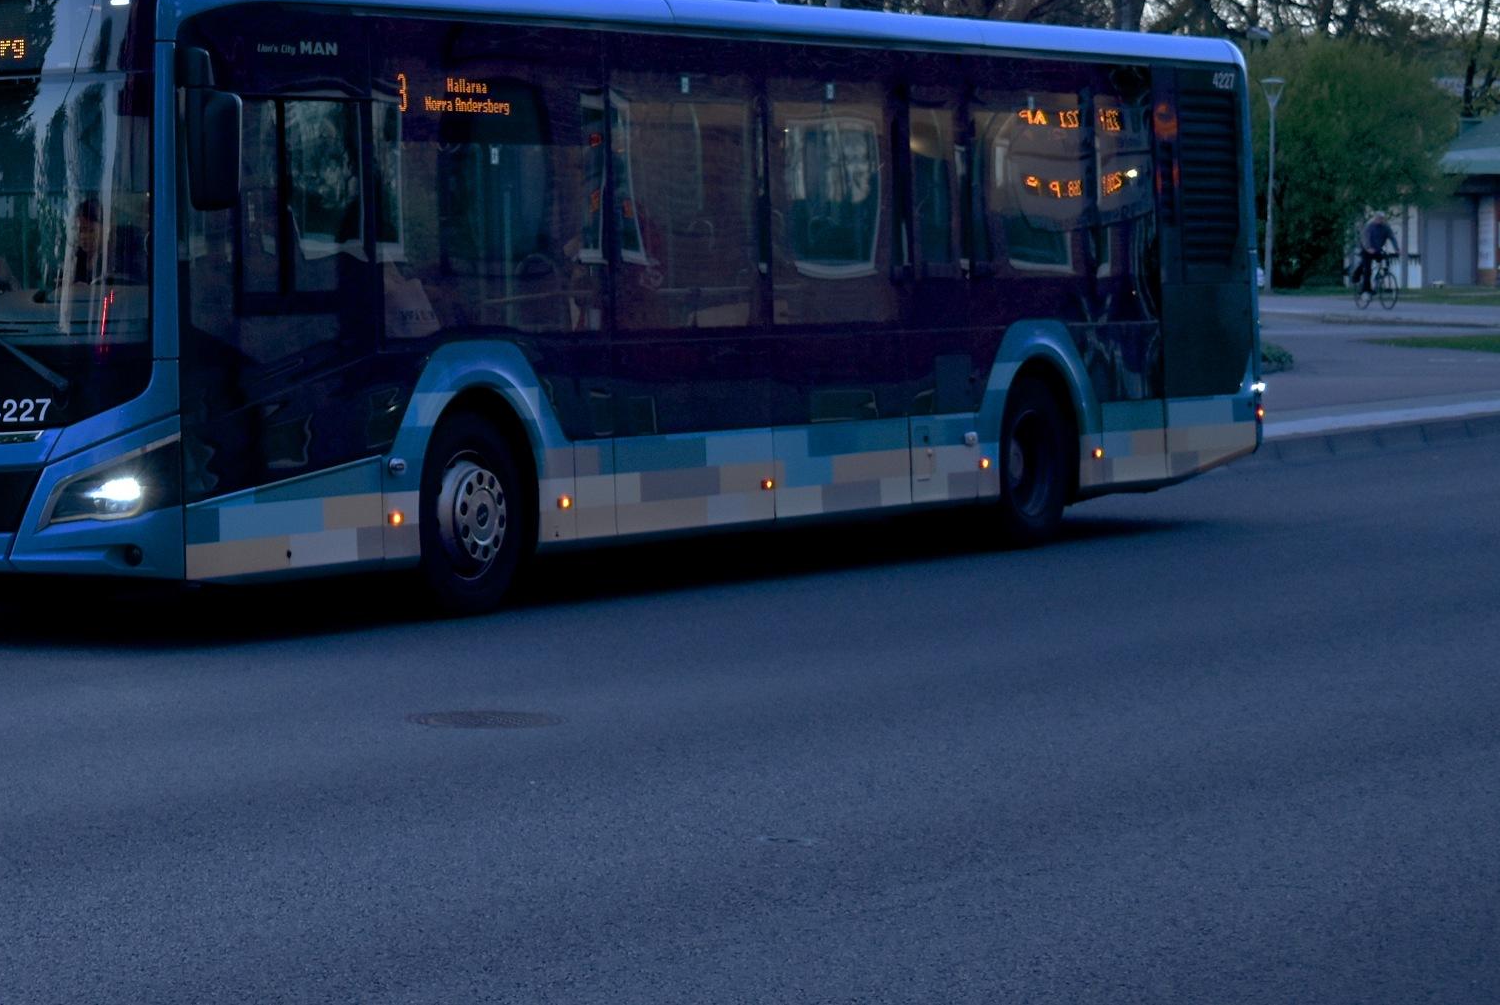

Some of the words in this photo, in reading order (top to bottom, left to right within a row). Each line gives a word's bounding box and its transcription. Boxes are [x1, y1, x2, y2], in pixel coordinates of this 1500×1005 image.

[281, 43, 297, 57] City
[300, 40, 339, 57] MAN
[446, 77, 488, 94] Hallarna
[1212, 71, 1236, 90] 4227
[397, 73, 408, 112] 3
[424, 96, 453, 112] Norra
[455, 97, 510, 116] Andersberg
